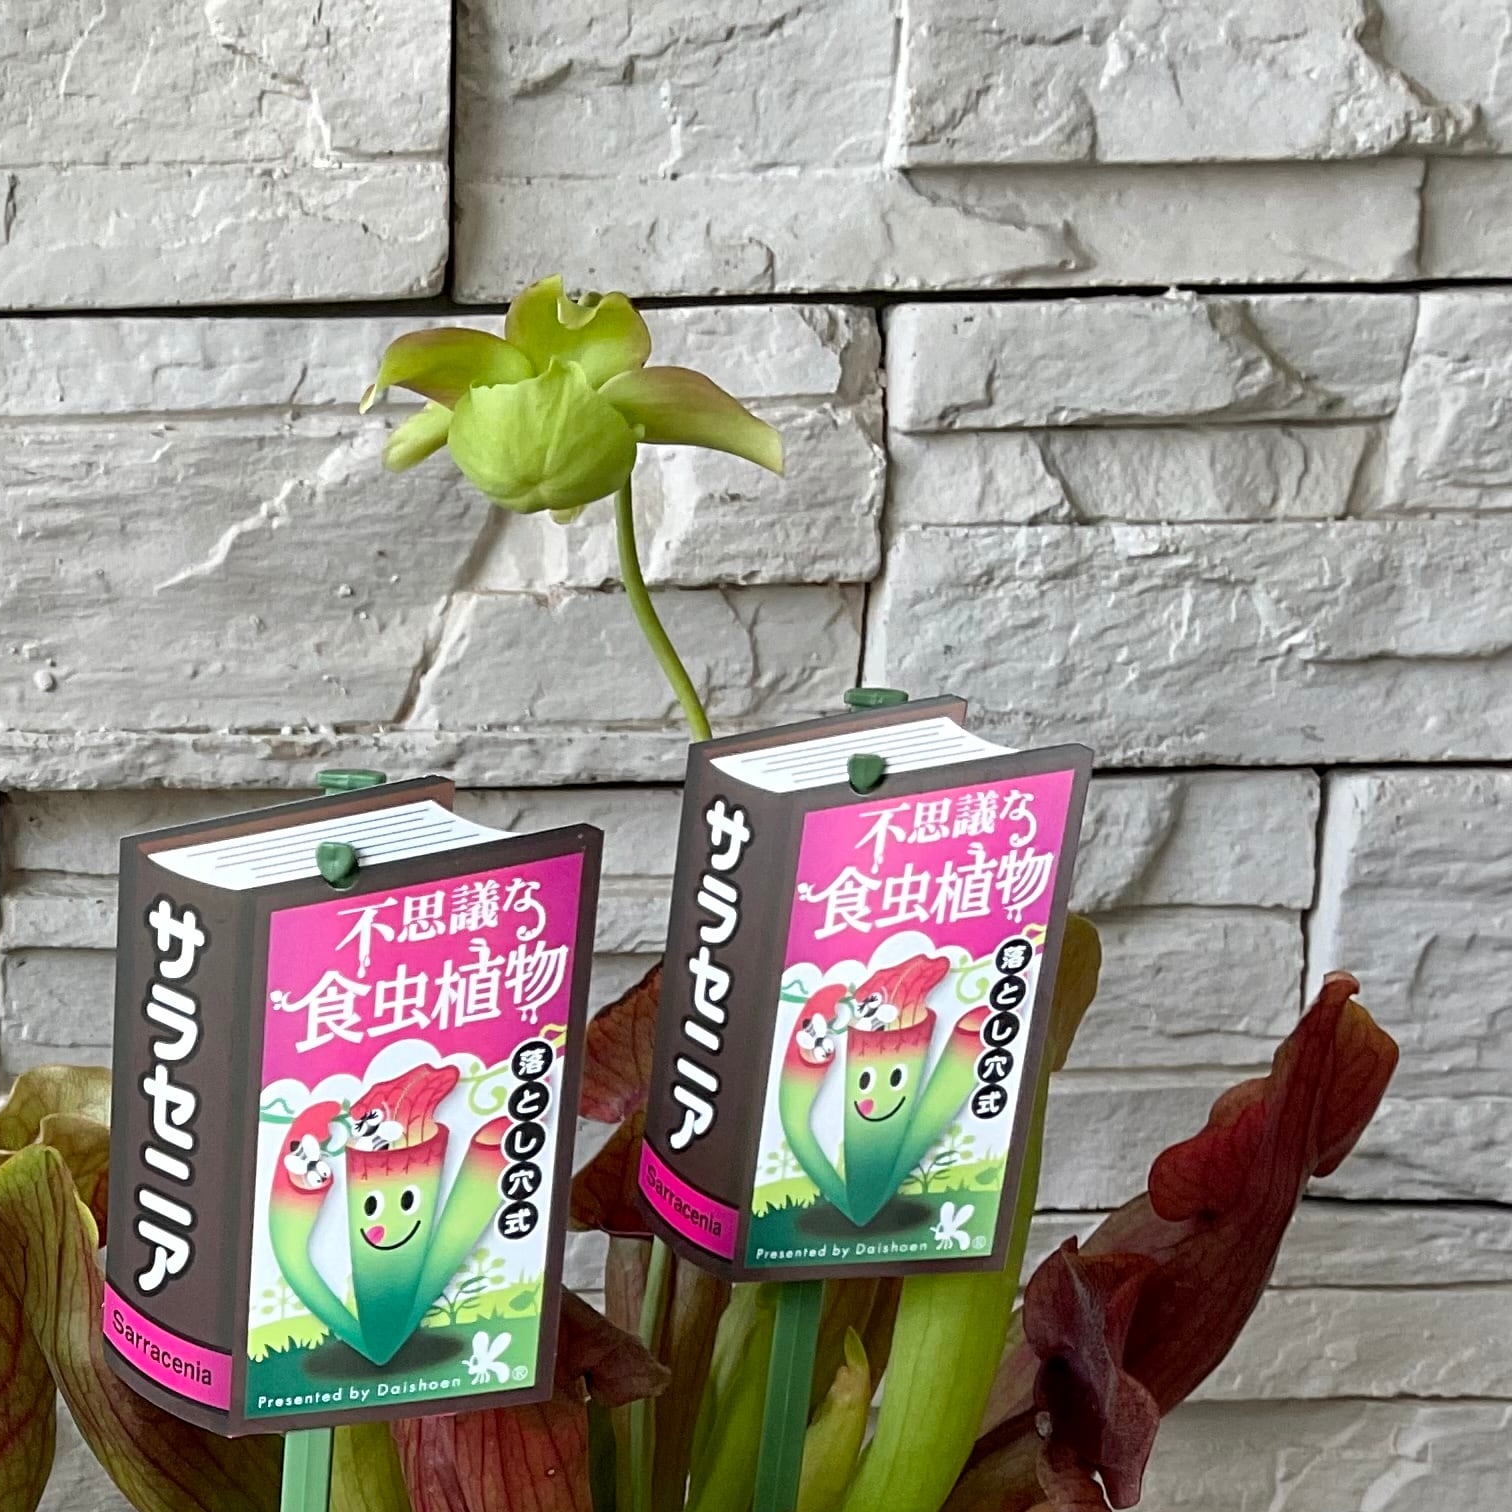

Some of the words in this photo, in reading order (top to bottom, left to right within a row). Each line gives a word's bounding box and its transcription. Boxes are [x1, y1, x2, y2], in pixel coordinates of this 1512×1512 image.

[854, 789, 1037, 874] 不思議な
[335, 877, 547, 977] 不思議な
[798, 842, 1054, 940] 食虫植物
[270, 938, 569, 1054] 食虫植物
[670, 799, 750, 1151] サラセニア
[976, 943, 1027, 1115] 落とし穴式
[137, 900, 205, 1292] サラセニア
[502, 1046, 547, 1235] 落とし穴式
[647, 1164, 722, 1236] Sarracenia
[755, 1245, 827, 1260] Presented
[832, 1244, 850, 1258] by
[112, 1308, 213, 1388] Sarracenia
[257, 1387, 342, 1409] Presented
[349, 1387, 370, 1401] by
[377, 1376, 461, 1397] Daishoen
